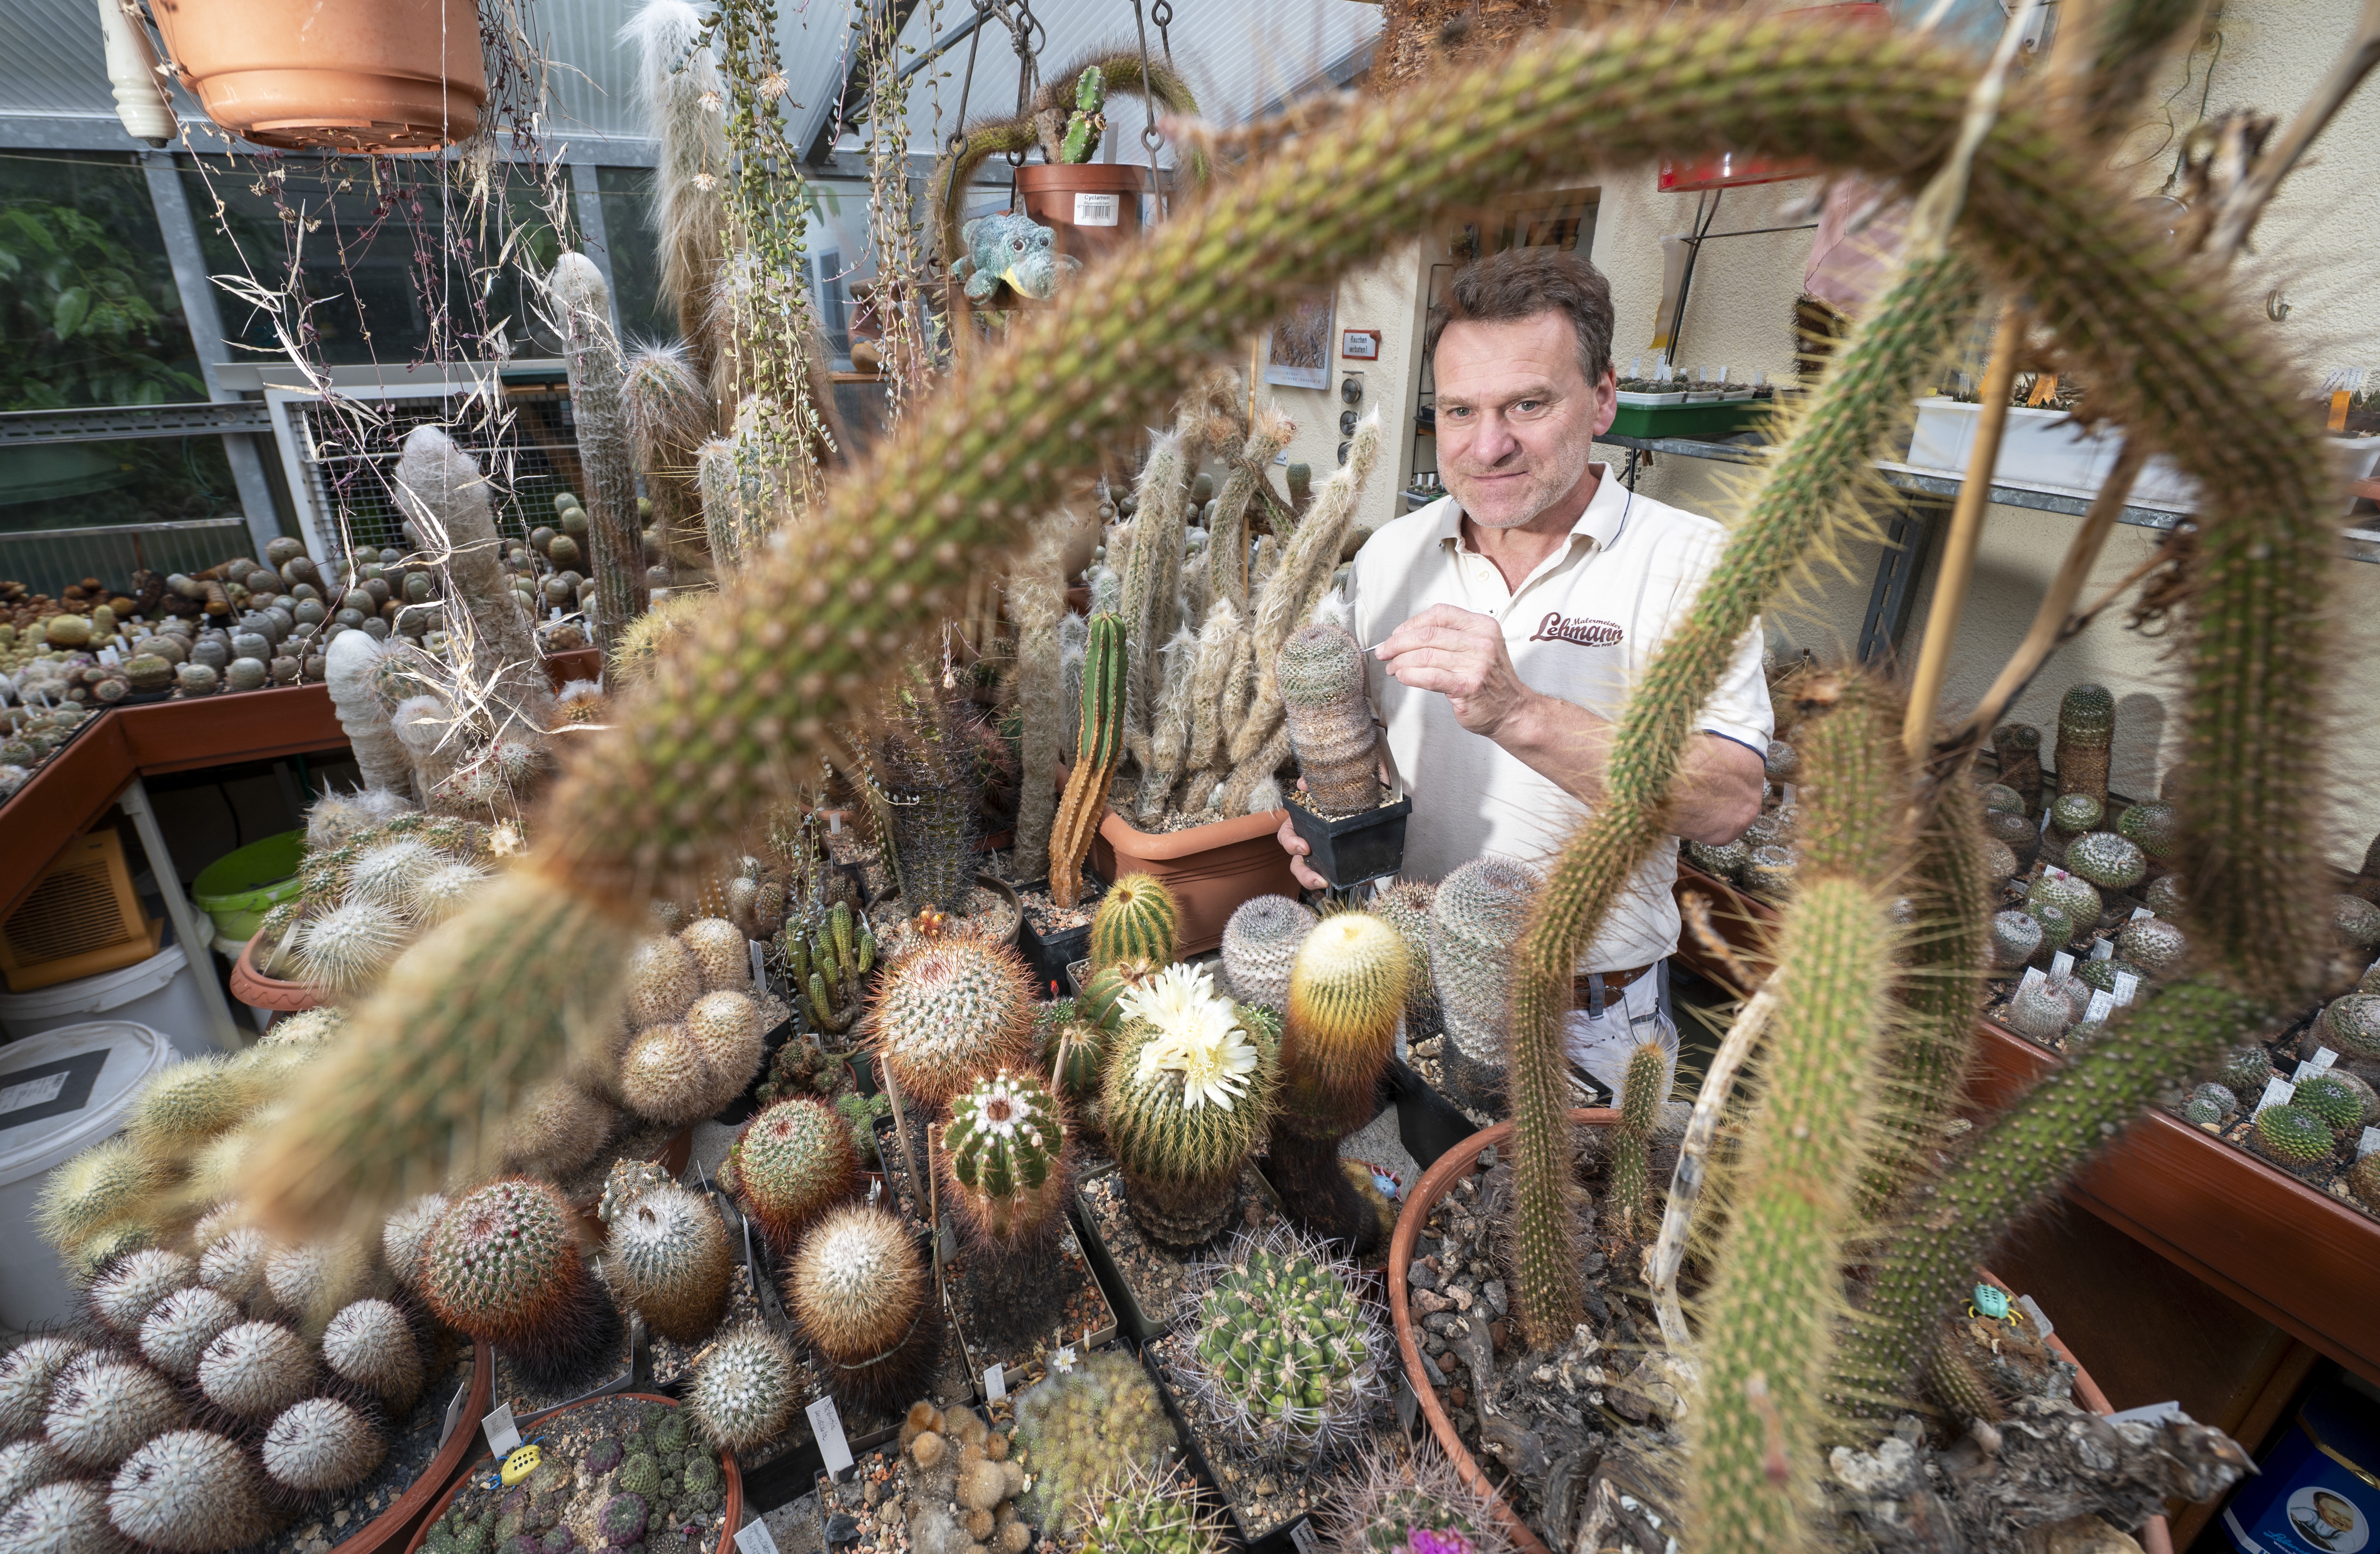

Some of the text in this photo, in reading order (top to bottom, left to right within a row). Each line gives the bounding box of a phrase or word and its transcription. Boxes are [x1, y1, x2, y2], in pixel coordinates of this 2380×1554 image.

[1350, 335, 1367, 343] Rauchen
[1349, 345, 1367, 353] verboten!
[1571, 617, 1620, 629] Malermeister
[1529, 612, 1623, 646] Lehmann
